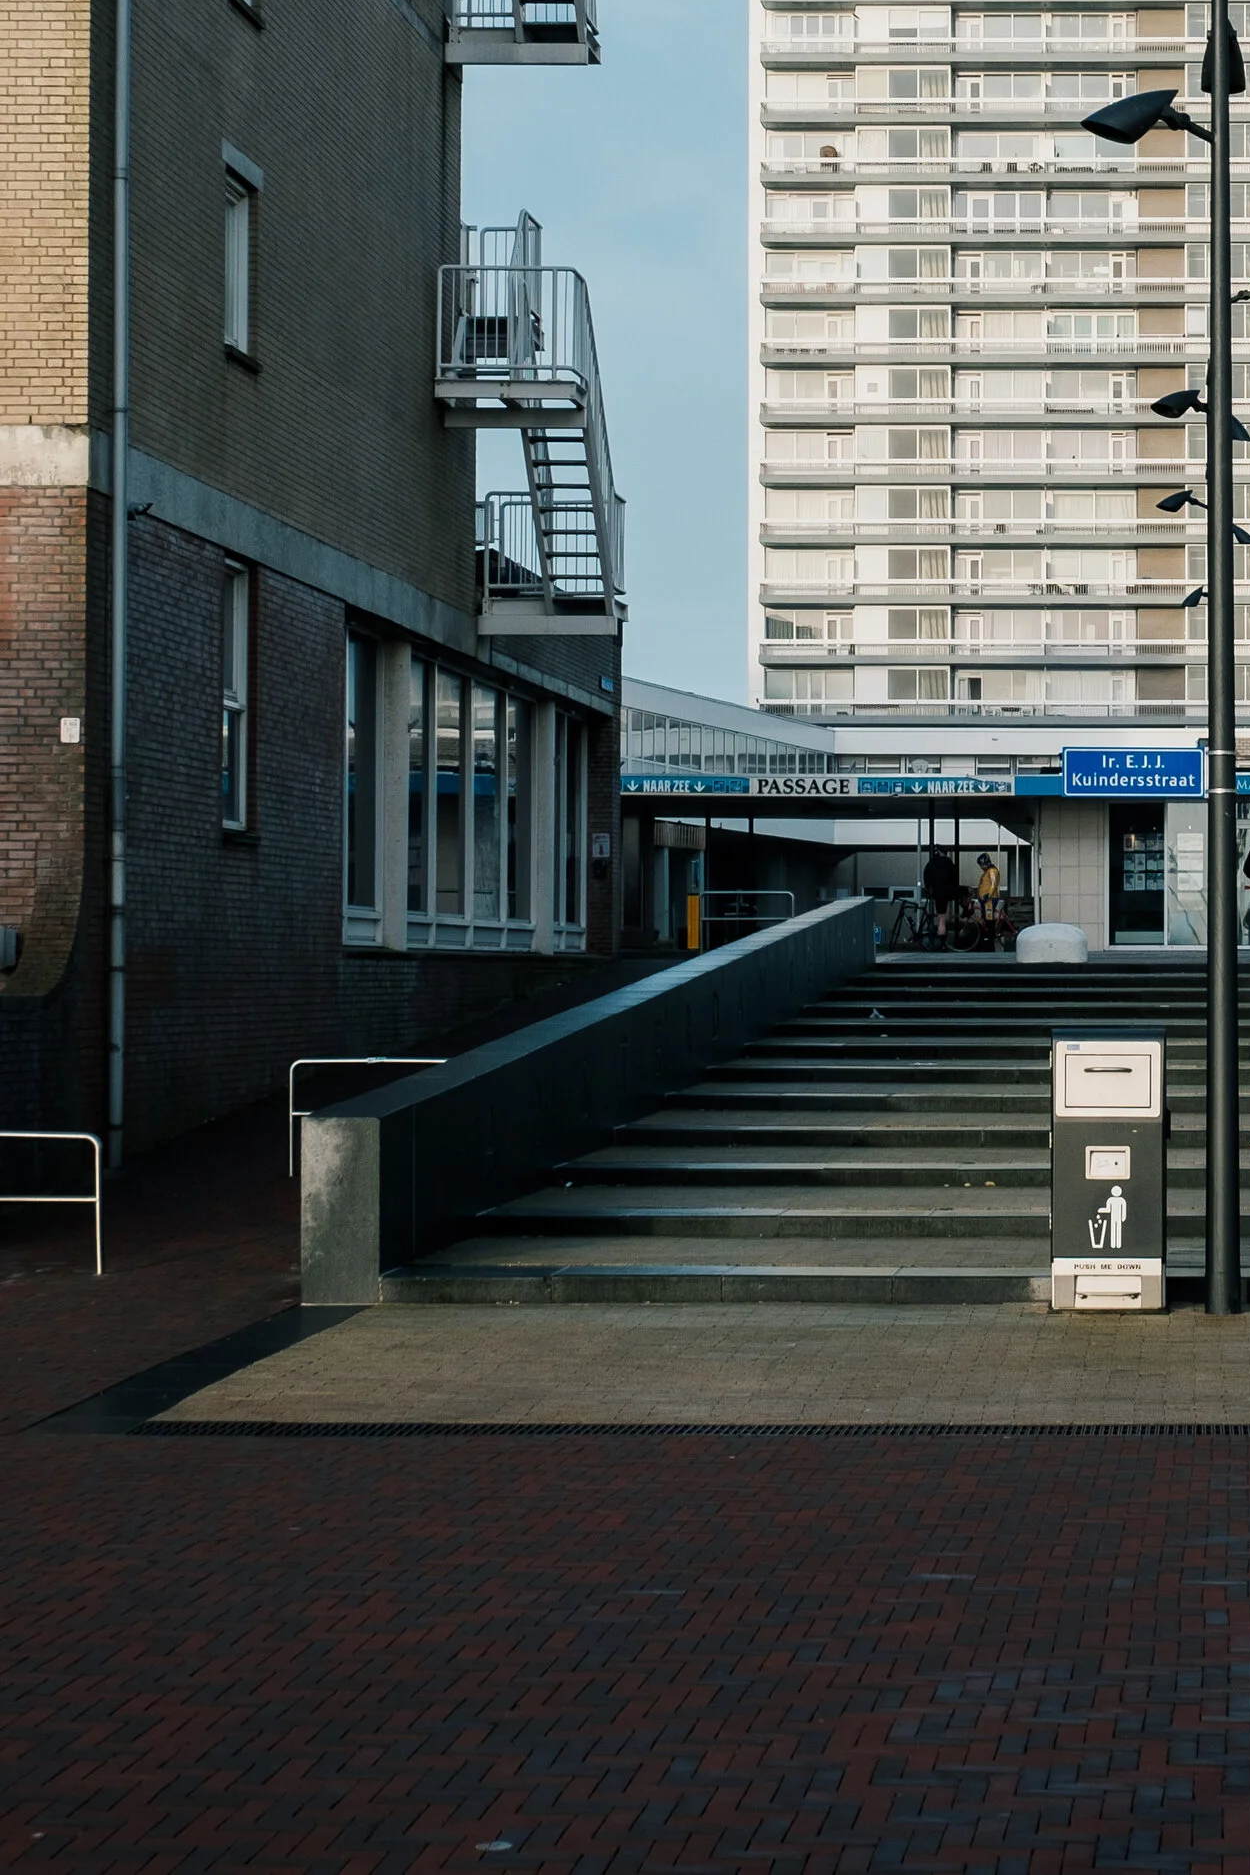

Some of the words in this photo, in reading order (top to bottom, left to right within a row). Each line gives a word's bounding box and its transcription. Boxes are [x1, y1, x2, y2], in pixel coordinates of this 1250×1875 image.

[1102, 755, 1120, 768] Ir.
[643, 779, 671, 793] NAAR
[672, 779, 690, 793] ZEE
[757, 778, 850, 794] PASSAGE
[927, 781, 956, 793] NAAR
[957, 780, 975, 793] ZEE
[1072, 773, 1195, 787] Kuindersstraat
